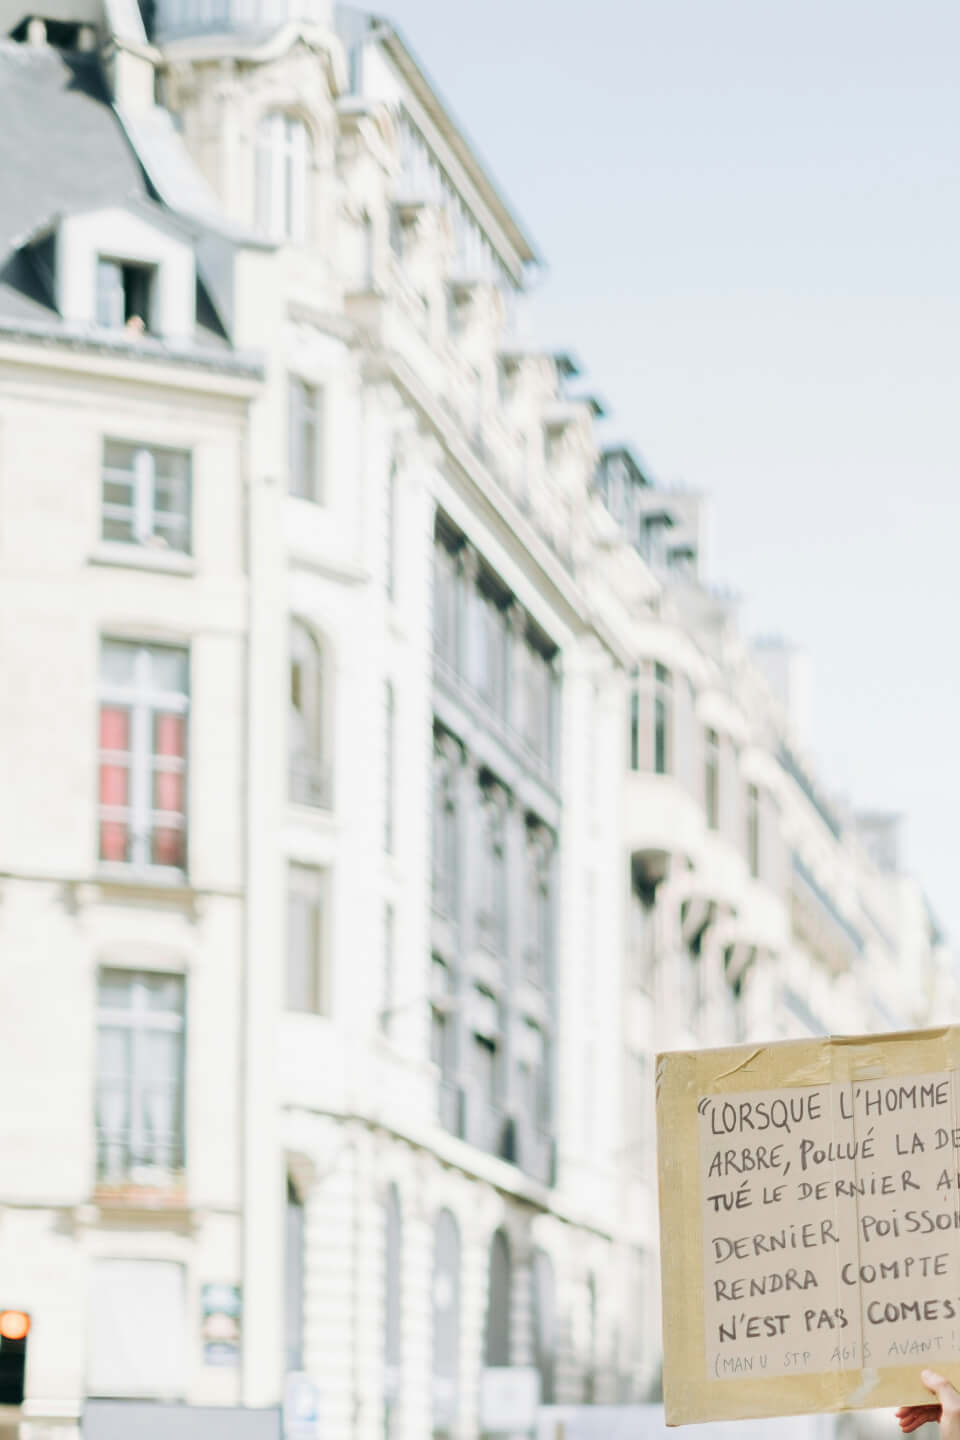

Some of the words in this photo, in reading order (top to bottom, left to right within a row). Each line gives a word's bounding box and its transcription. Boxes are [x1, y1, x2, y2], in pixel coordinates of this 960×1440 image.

[839, 1081, 950, 1120] L'HOMME
[708, 1144, 791, 1177] ARBRE,
[895, 1132, 925, 1156] LA
[707, 1179, 752, 1213] TUÉ
[762, 1184, 788, 1205] LE
[714, 1268, 819, 1302] RENDRA
[841, 1252, 950, 1286] COMPTE
[718, 1312, 791, 1343] N'EST
[804, 1308, 849, 1332] PAS
[783, 1351, 811, 1368] STP
